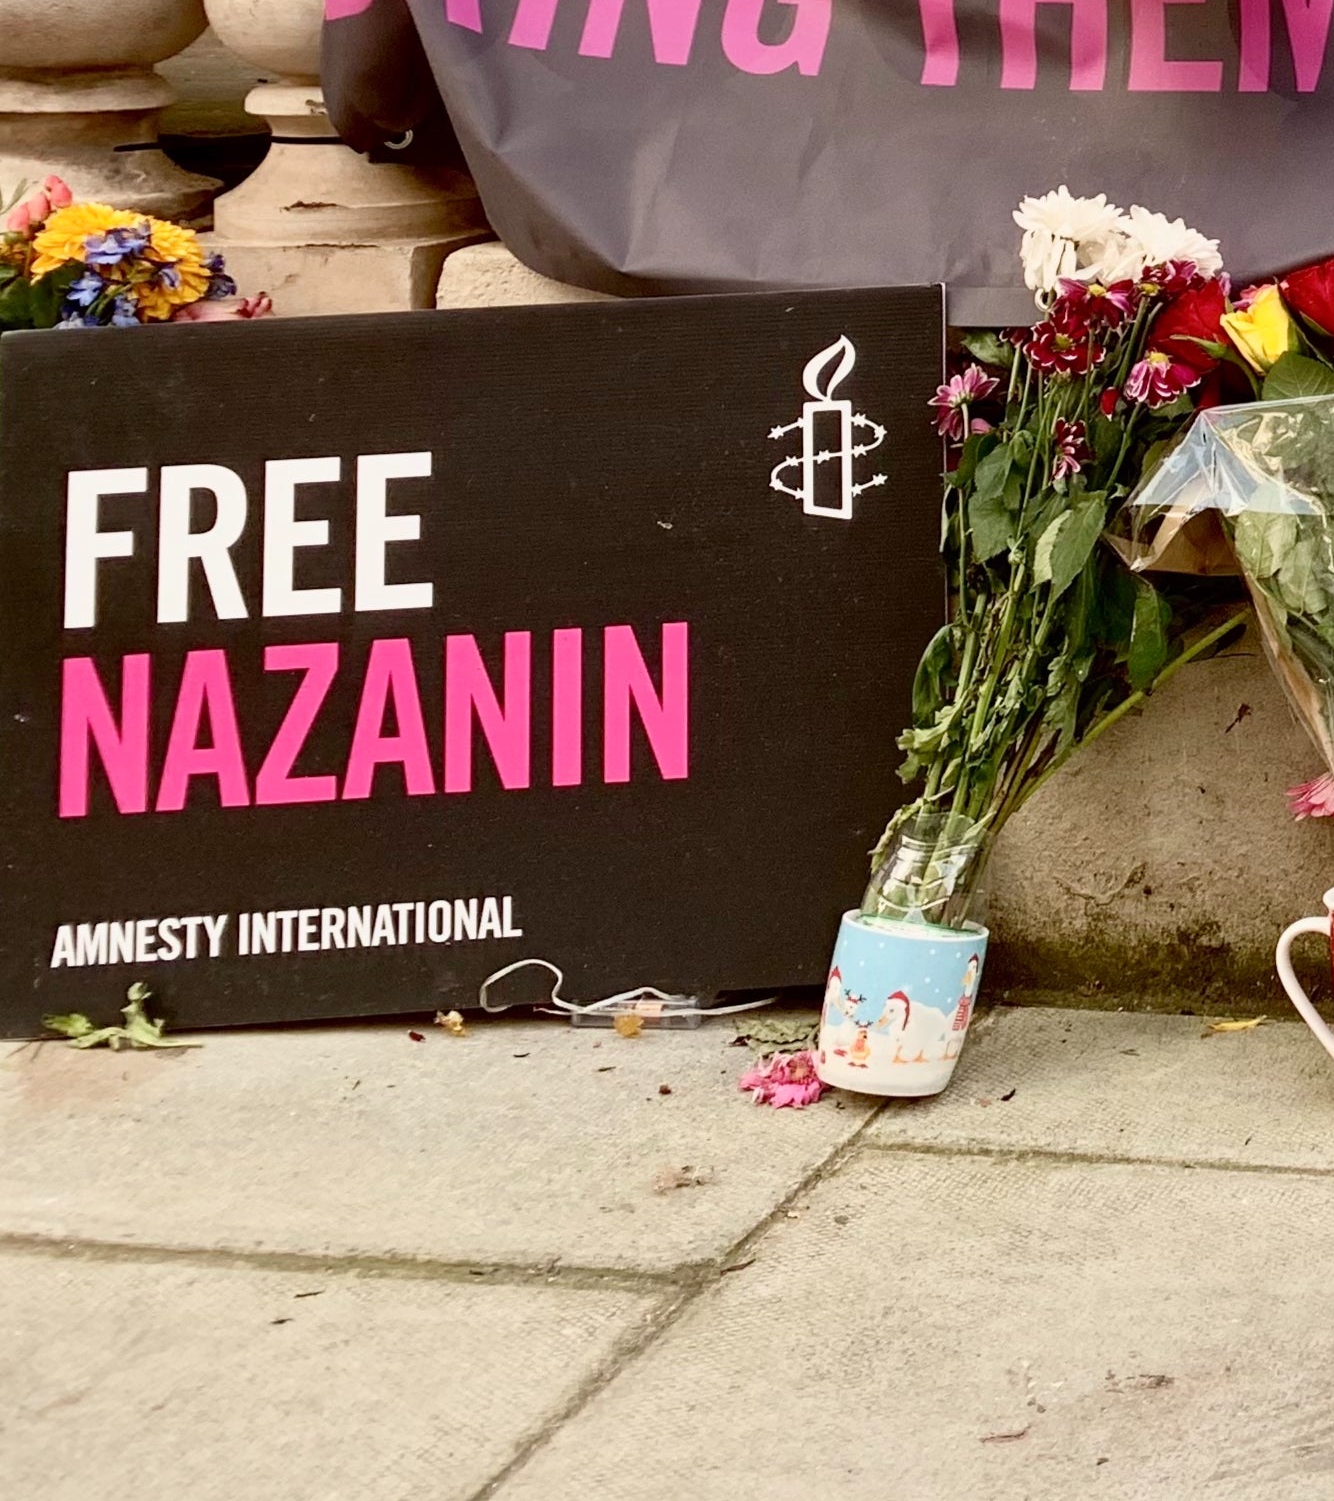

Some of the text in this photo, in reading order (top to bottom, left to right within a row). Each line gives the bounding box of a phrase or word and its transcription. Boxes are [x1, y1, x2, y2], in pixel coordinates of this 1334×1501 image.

[63, 451, 434, 629] FREE
[59, 621, 690, 818] NAZANIN
[50, 895, 523, 968] AMNESTY INTERNATIONAL
